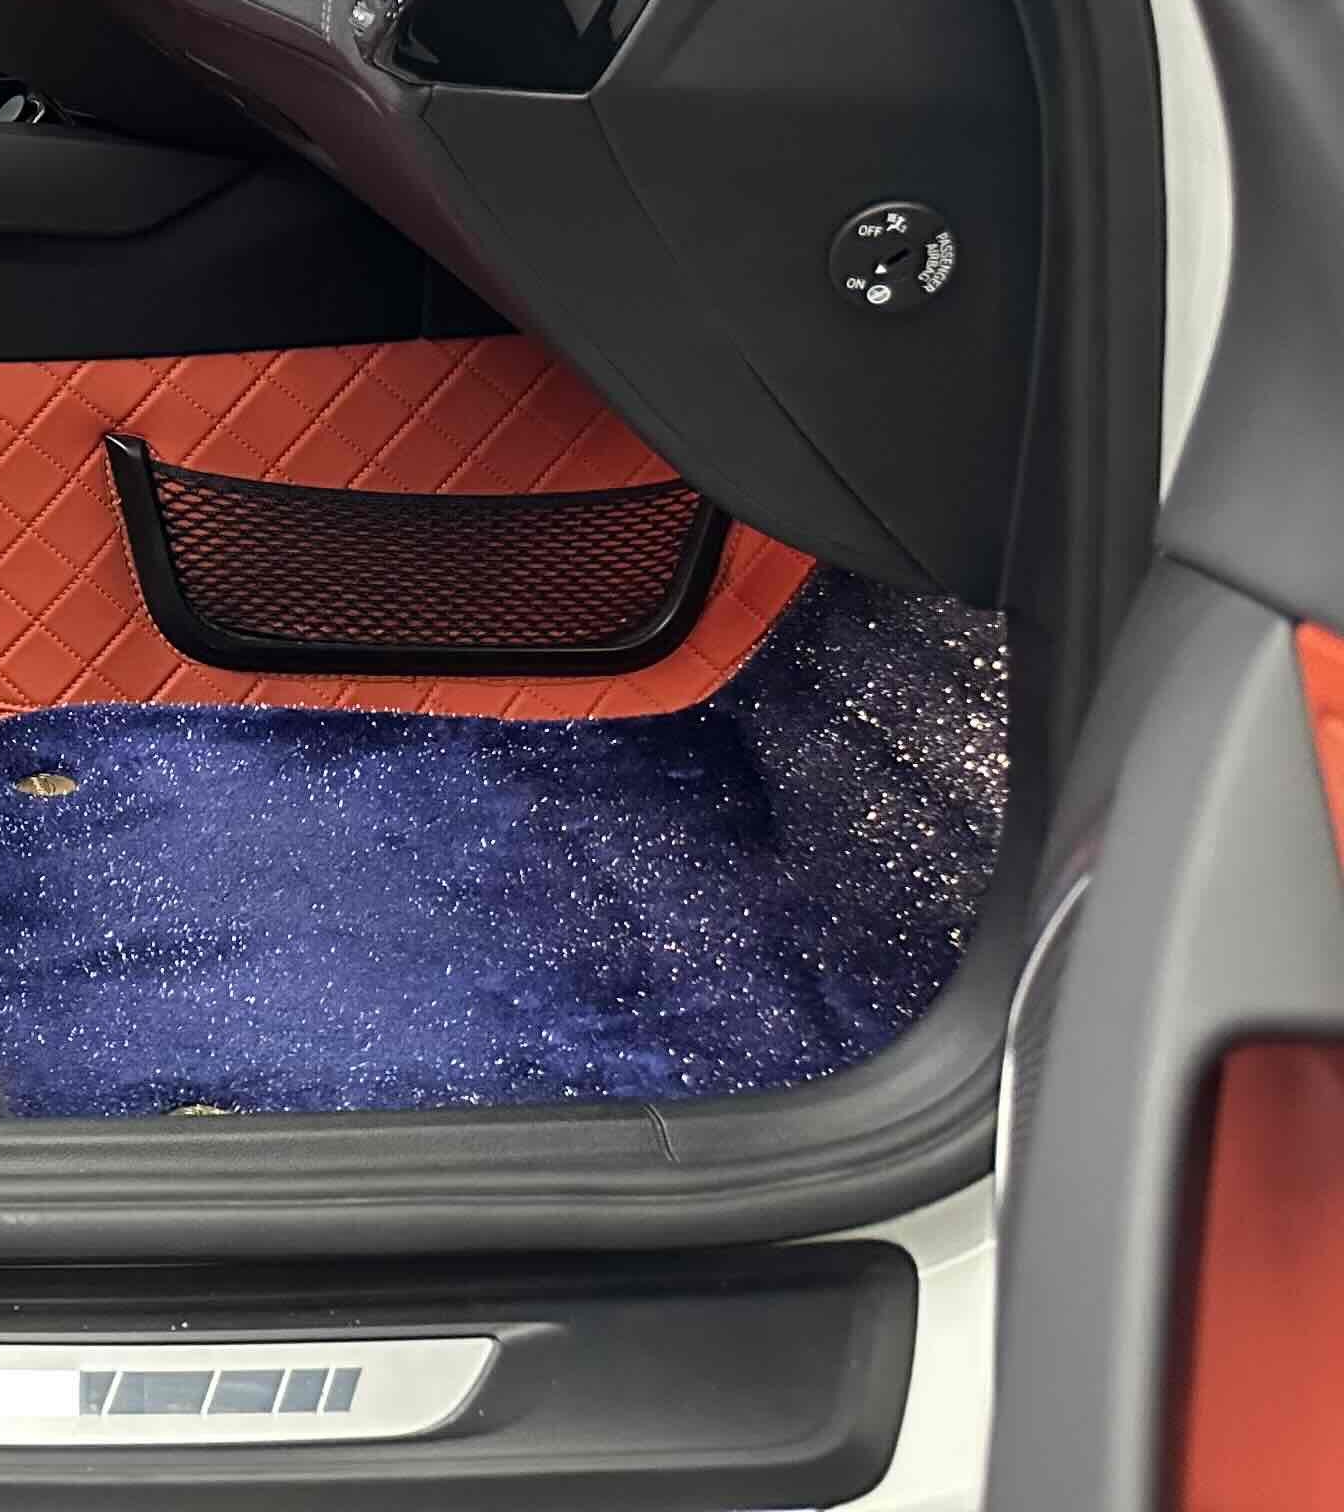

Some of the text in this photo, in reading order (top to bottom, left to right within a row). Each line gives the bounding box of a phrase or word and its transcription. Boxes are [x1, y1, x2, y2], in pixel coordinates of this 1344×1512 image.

[858, 225, 883, 237] OFF
[918, 243, 938, 283] AIRBAG
[922, 232, 953, 292] PASSENGER
[846, 277, 866, 290] ON
